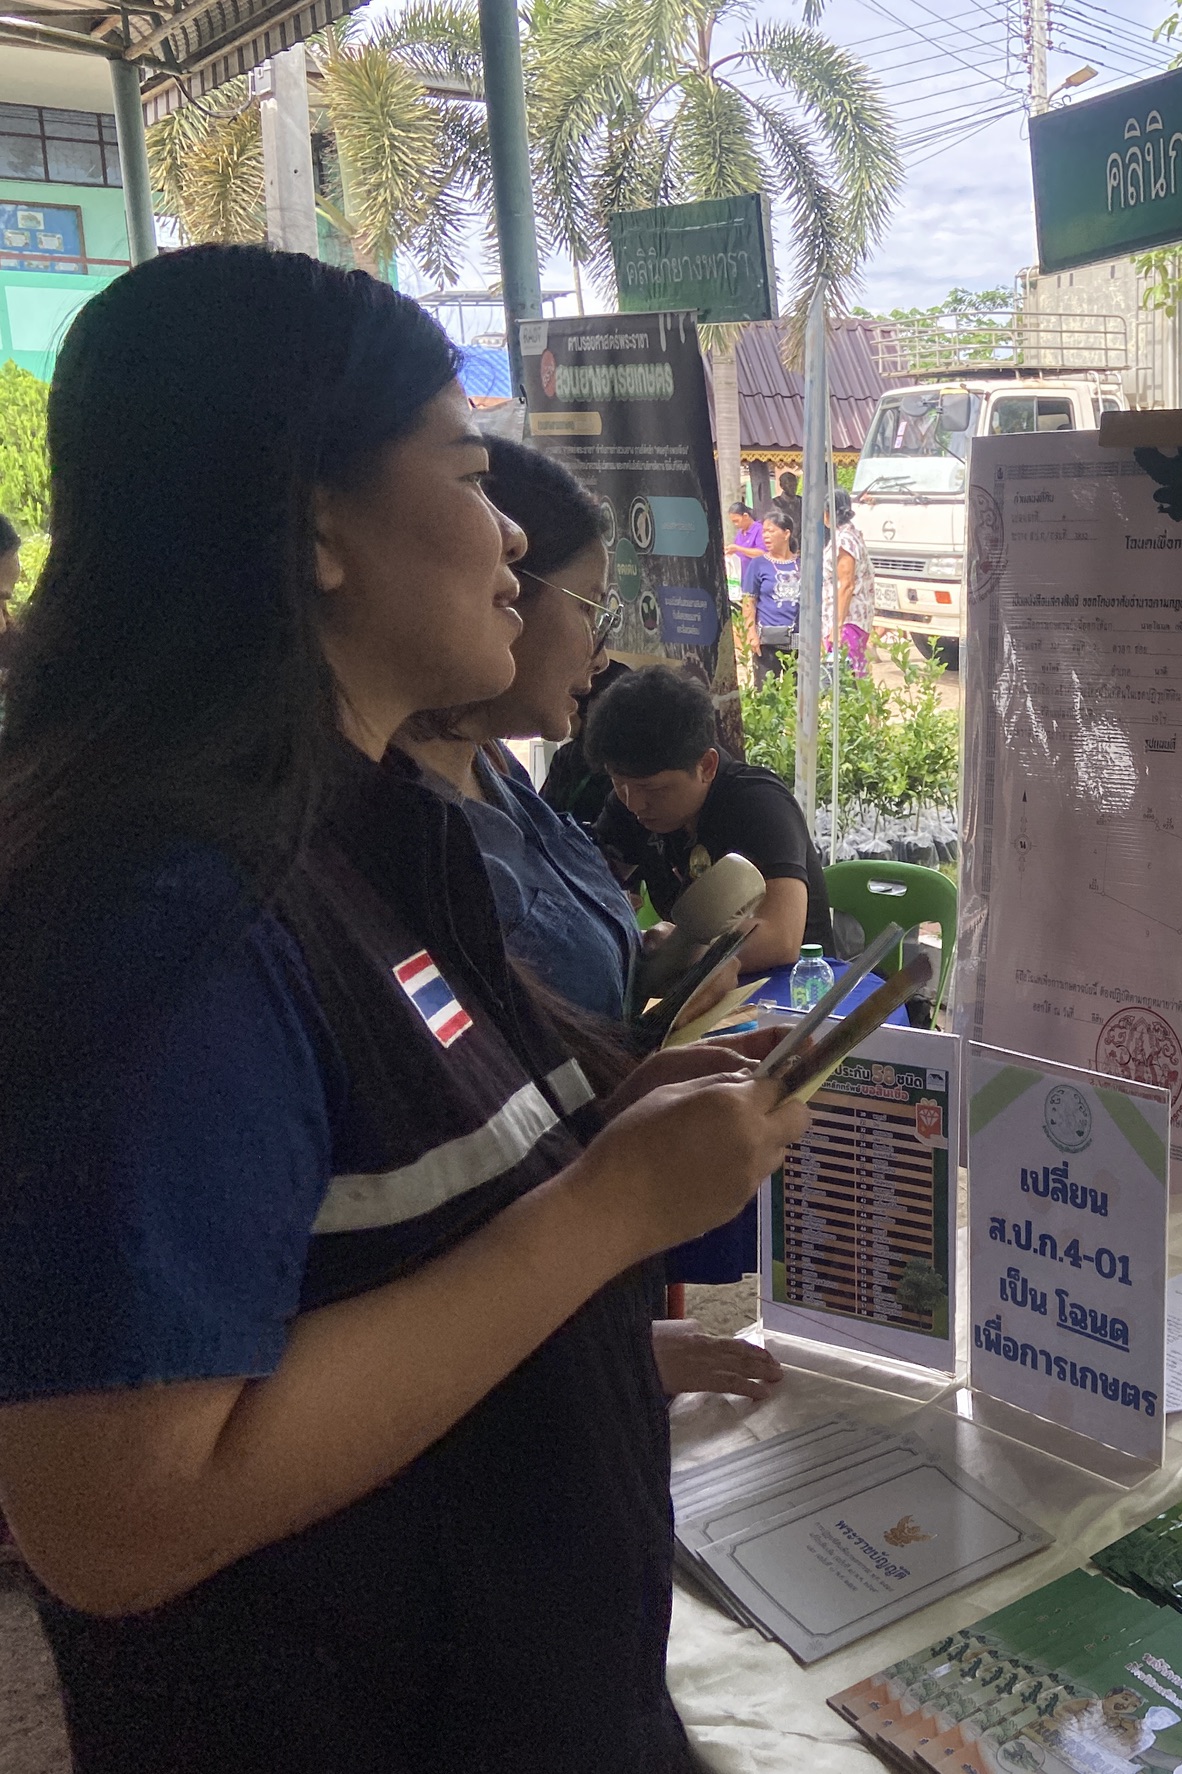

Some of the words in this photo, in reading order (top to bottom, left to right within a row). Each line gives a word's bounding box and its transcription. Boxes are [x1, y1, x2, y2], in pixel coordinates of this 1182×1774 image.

[626, 247, 749, 285] คลินิกยางพารา
[831, 1064, 871, 1081] ประกัน
[872, 1063, 896, 1085] 58
[896, 1072, 924, 1090] ชนิด
[1020, 1161, 1109, 1217] เปลี่ยน
[988, 1216, 1133, 1287] ส.ป.ก.4-01
[1000, 1266, 1048, 1315] เป็น
[1055, 1288, 1130, 1346] โฉนด
[974, 1314, 1158, 1417] เพื่อการเกษตร
[835, 1519, 911, 1581] พระราชบัญญัติ
